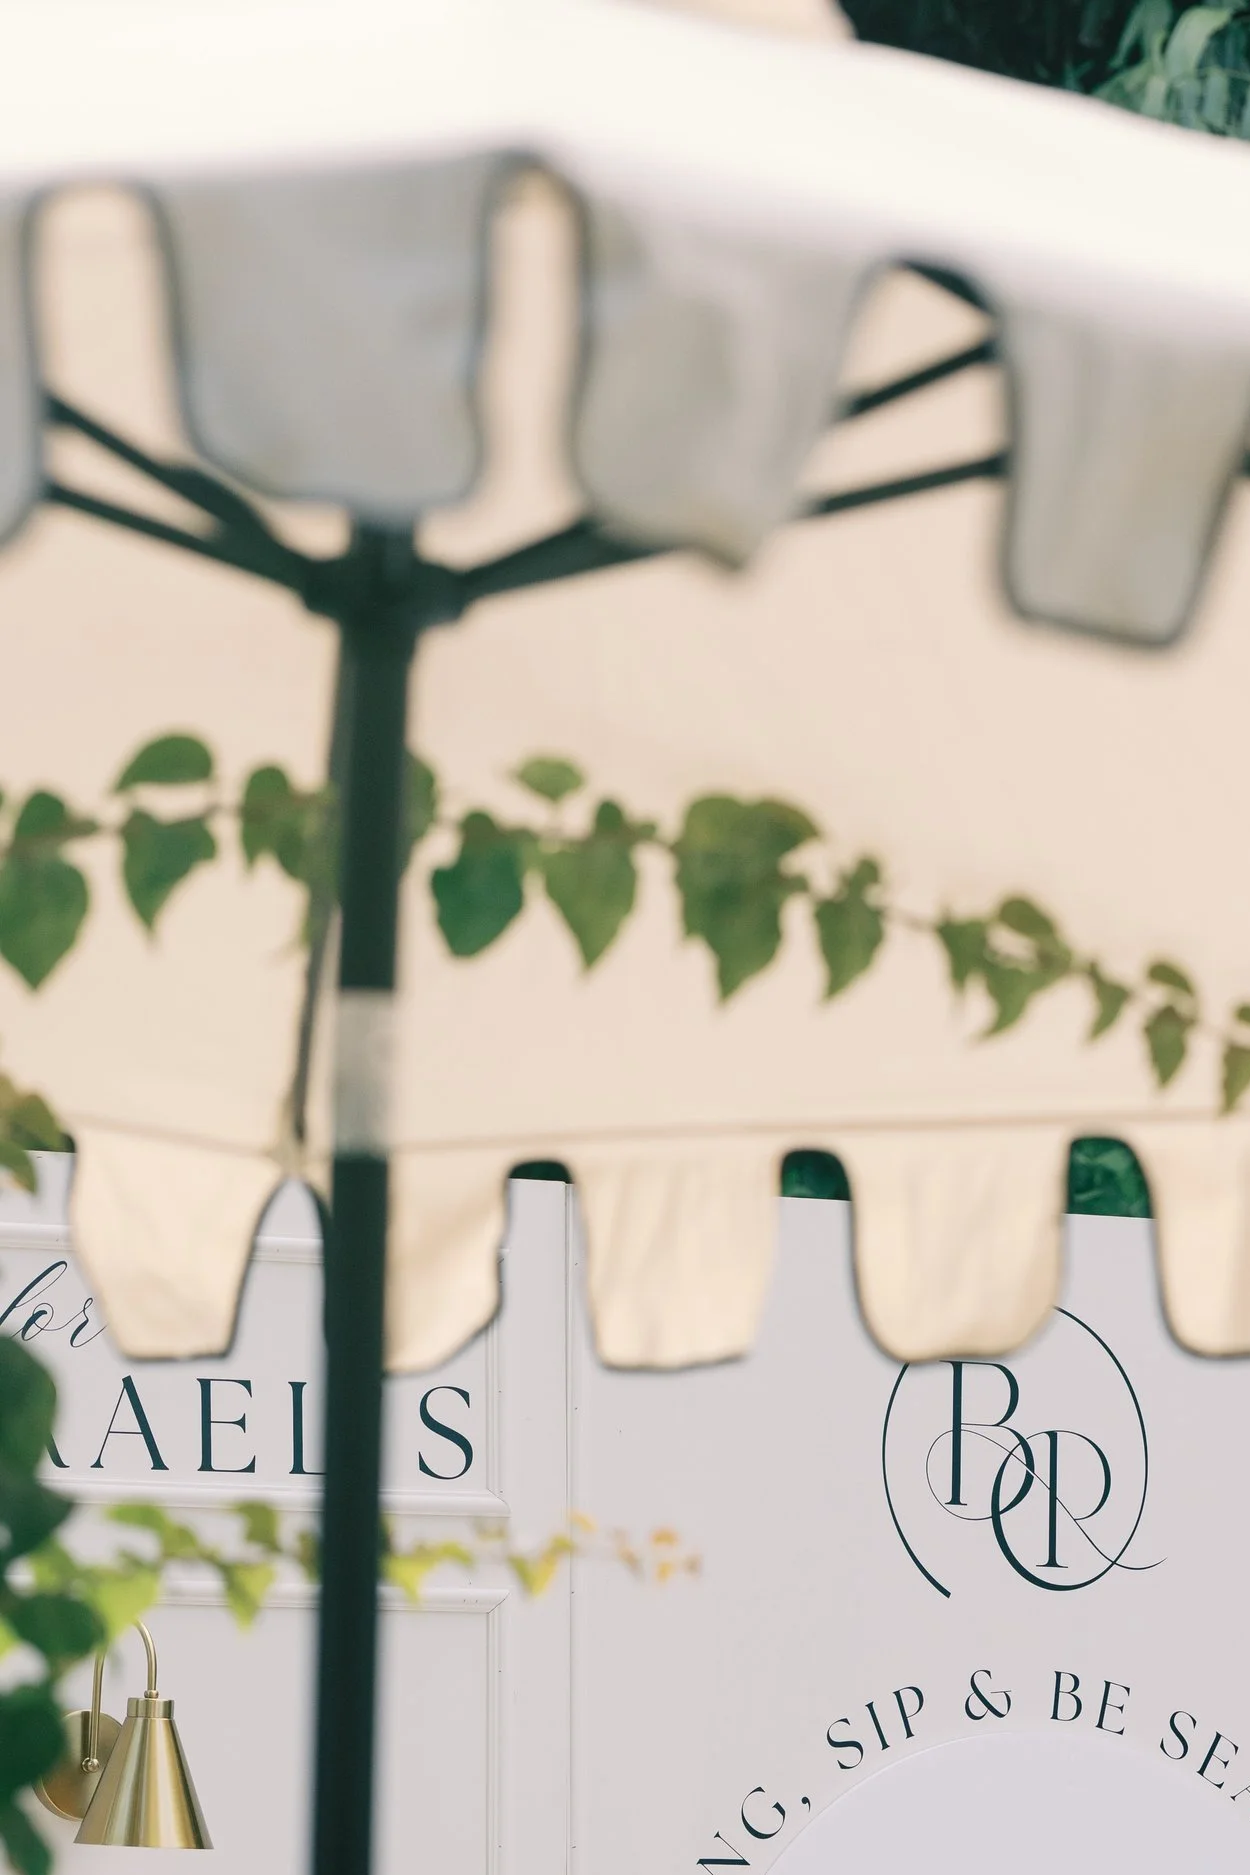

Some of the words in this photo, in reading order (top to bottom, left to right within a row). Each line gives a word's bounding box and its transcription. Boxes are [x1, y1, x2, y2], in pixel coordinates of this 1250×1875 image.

[45, 1375, 474, 1480] AELS
[826, 1686, 925, 1770] SIP
[964, 1669, 1012, 1721] &
[1050, 1670, 1131, 1735] BE
